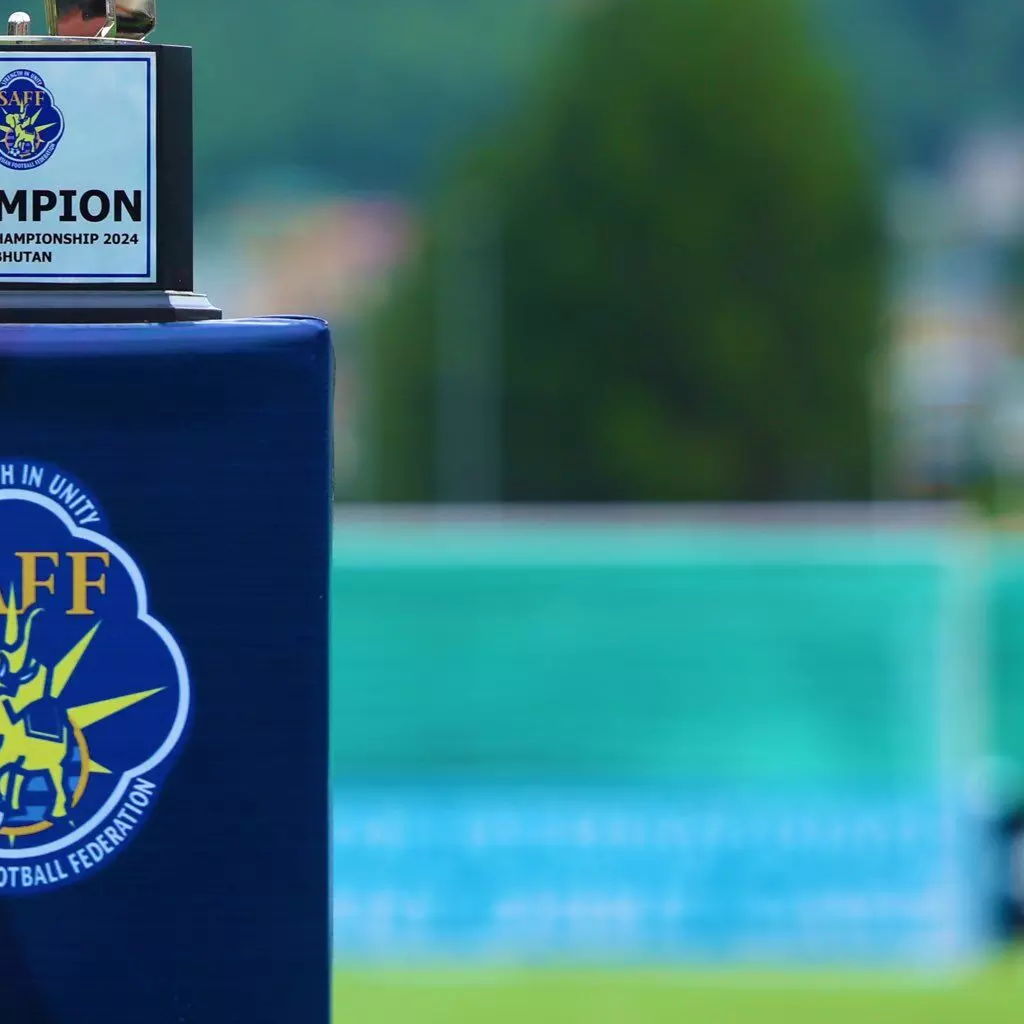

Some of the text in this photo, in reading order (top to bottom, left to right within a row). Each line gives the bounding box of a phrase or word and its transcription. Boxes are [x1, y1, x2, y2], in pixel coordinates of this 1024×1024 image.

[103, 233, 139, 245] 2024
[22, 464, 44, 487] IN
[49, 474, 101, 525] UNITY
[69, 777, 157, 874] FEDERATION
